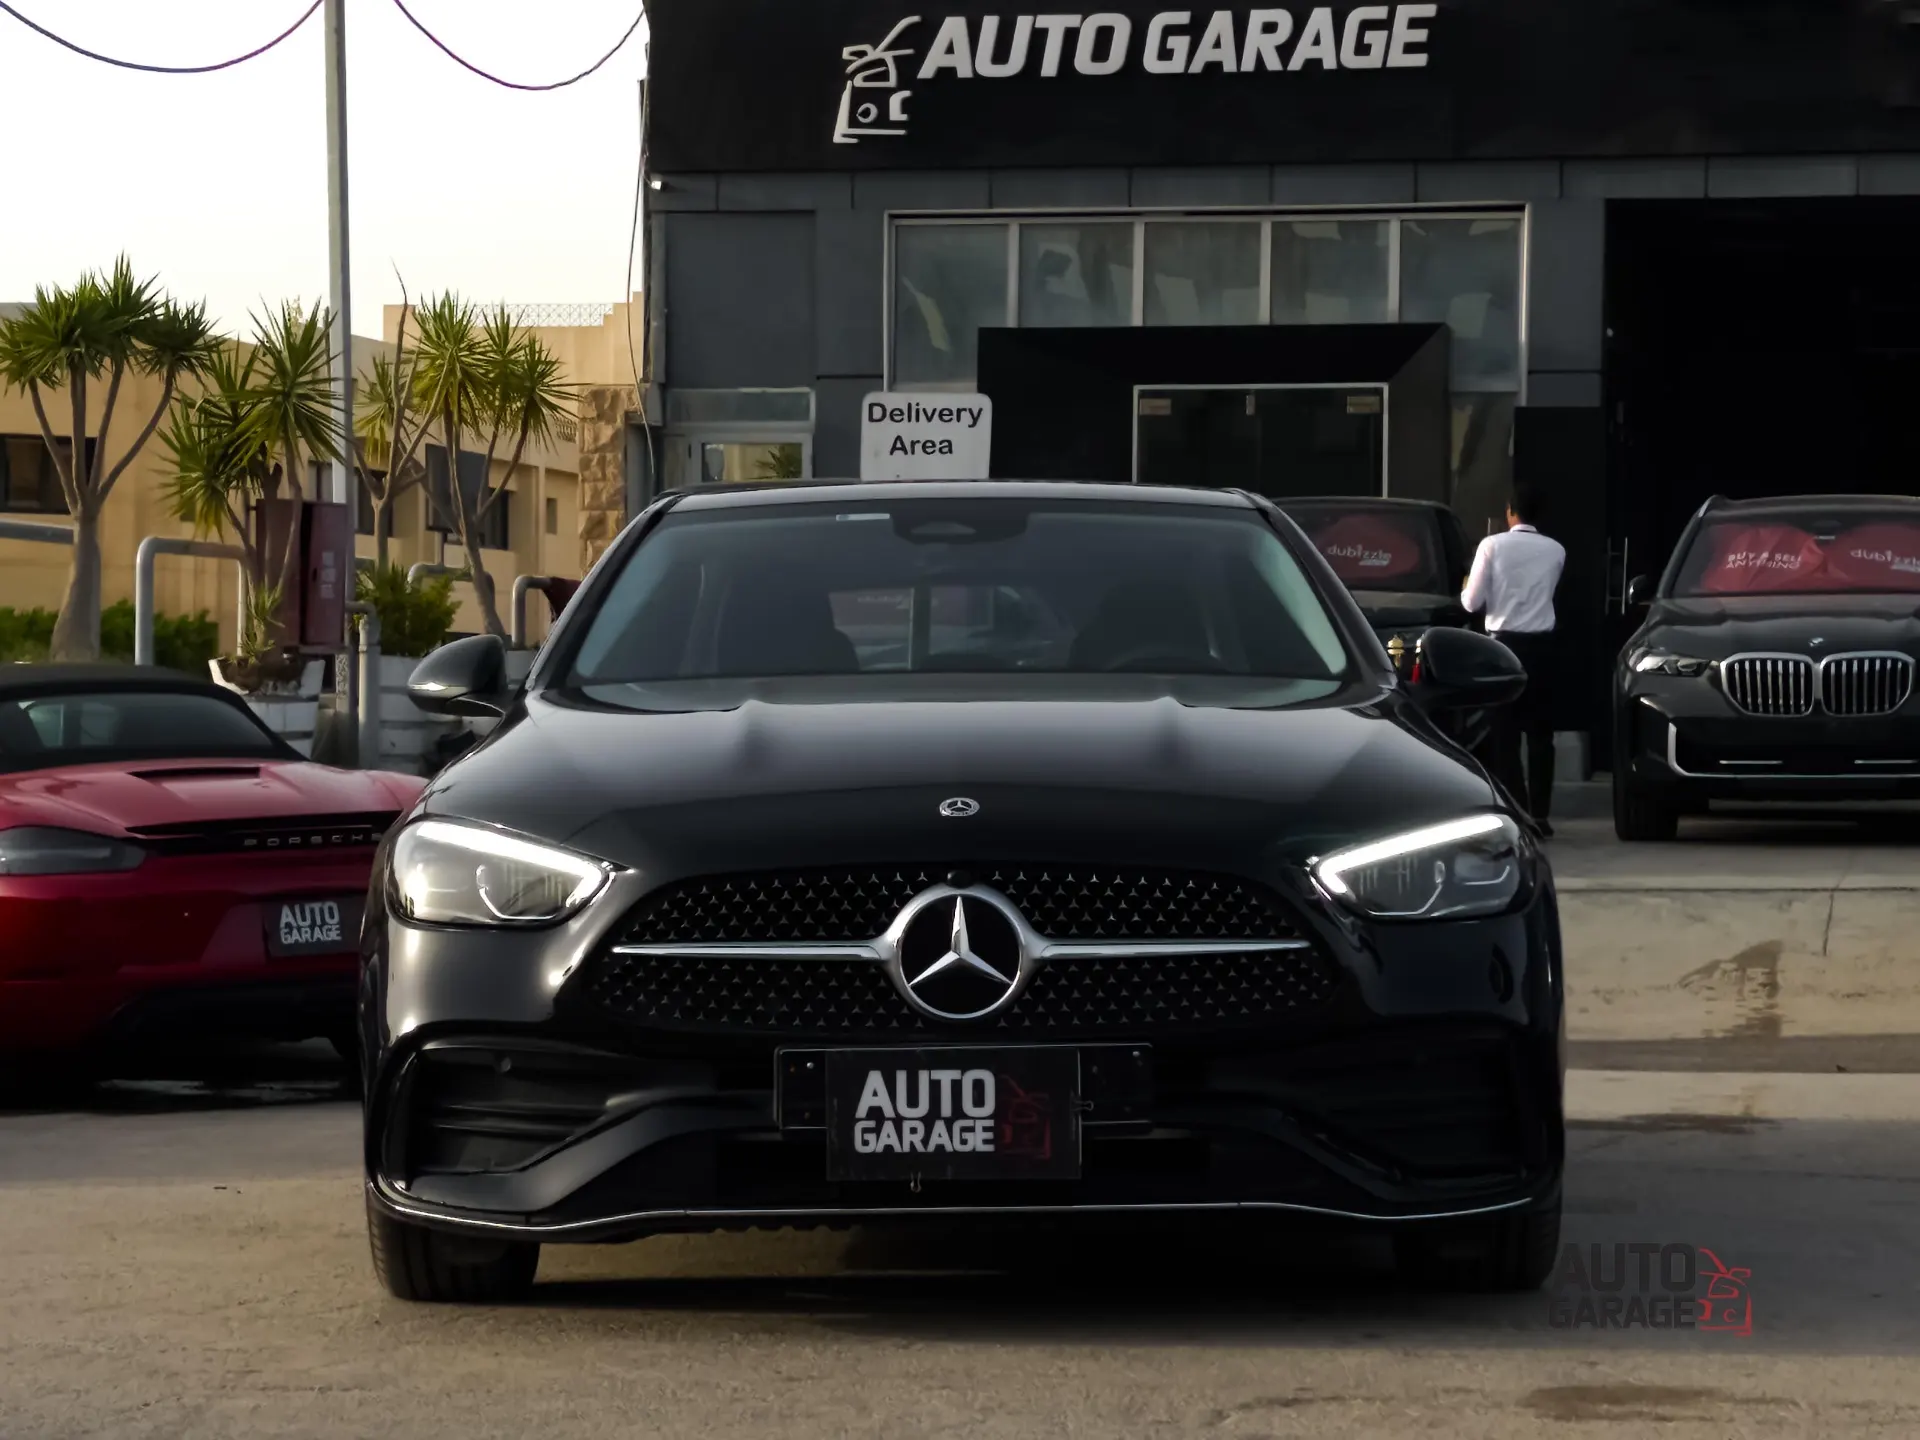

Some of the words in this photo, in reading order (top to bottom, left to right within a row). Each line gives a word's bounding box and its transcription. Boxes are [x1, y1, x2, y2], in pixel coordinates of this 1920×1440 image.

[918, 13, 1132, 79] AUTO
[1142, 4, 1438, 74] GARAGE
[868, 402, 983, 428] Delivery
[889, 434, 954, 456] Area
[1728, 551, 1756, 562] BUY
[279, 901, 340, 928] AUTO
[280, 924, 342, 944] GARAGE
[855, 1069, 995, 1119] AUTO
[854, 1119, 995, 1153] GARAGE
